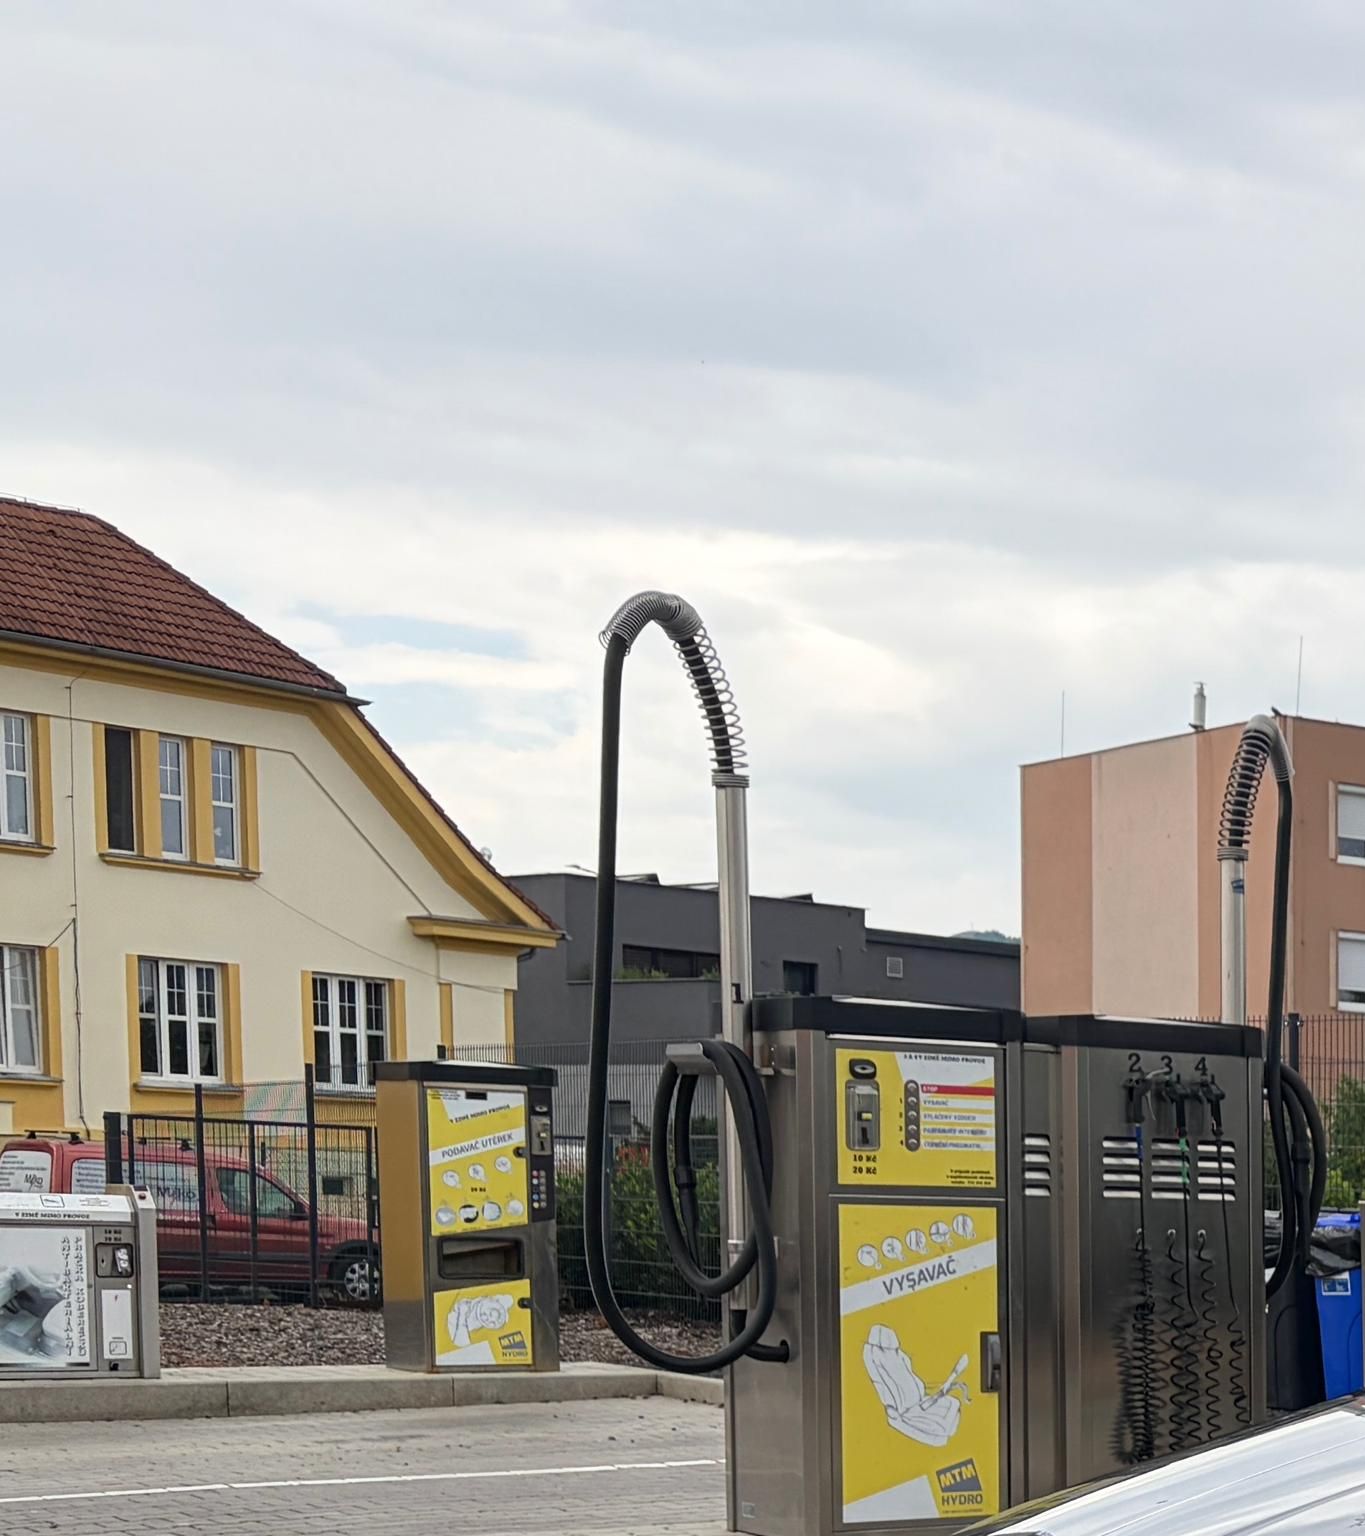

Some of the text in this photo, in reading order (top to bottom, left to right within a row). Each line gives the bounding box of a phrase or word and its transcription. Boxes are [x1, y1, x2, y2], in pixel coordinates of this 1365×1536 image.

[1128, 1052, 1208, 1076] 2 3 4
[441, 1140, 480, 1159] PODAVAČ
[853, 1154, 877, 1163] 10 Kč
[853, 1165, 877, 1175] 20 Kč
[882, 1254, 957, 1295] VYSAVAČ
[940, 1463, 976, 1489] MTM
[941, 1493, 983, 1506] HYDRO
